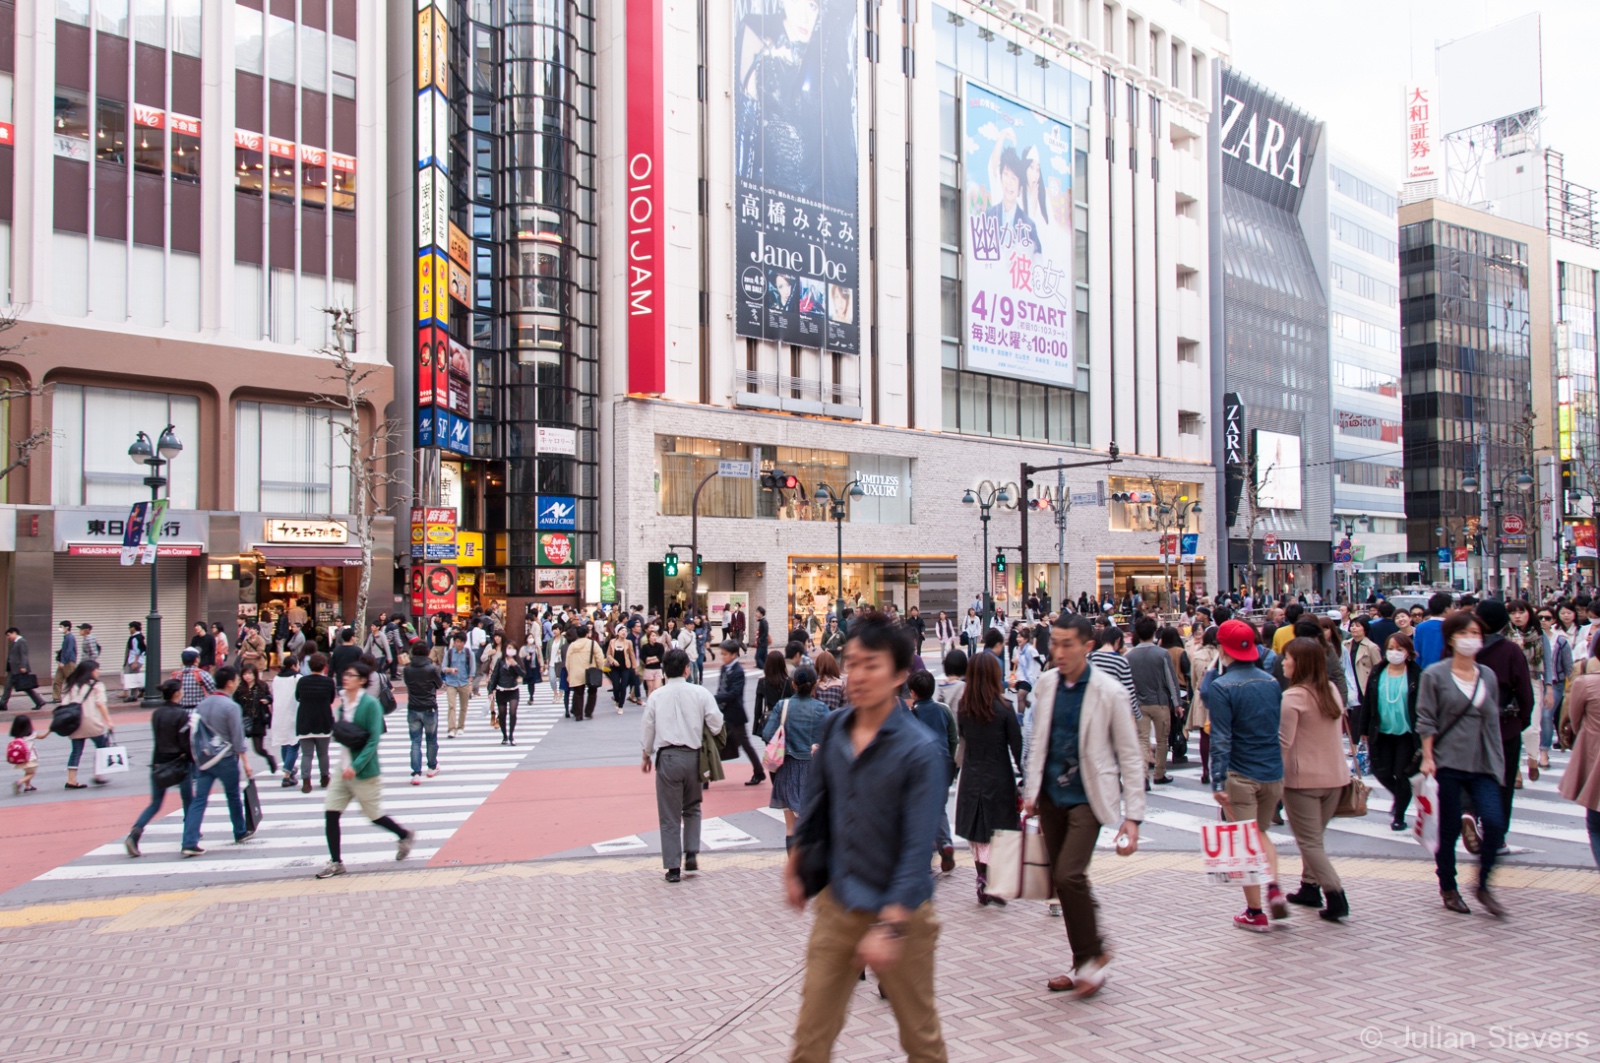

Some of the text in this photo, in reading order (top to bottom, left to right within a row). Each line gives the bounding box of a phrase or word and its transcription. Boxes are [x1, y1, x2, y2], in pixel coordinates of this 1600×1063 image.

[135, 107, 159, 126] We
[1409, 87, 1430, 159] 大和証券
[237, 131, 259, 150] We
[301, 148, 322, 165] We
[1221, 94, 1301, 188] ZARA
[629, 152, 652, 316] OIOIJAM
[741, 193, 854, 243] 高橋みなみ
[741, 218, 854, 252] MINAMI TAKAHASHI
[970, 213, 1033, 261] 幽かな
[750, 230, 847, 283] Jane Doe
[971, 290, 1067, 328] 4/9 START
[437, 417, 448, 438] 5F
[1225, 405, 1241, 465] ZARA
[720, 462, 750, 472] 神南一丁目
[855, 470, 899, 486] LIMITLESS
[862, 483, 899, 497] UXURY
[87, 519, 181, 537] 東日行
